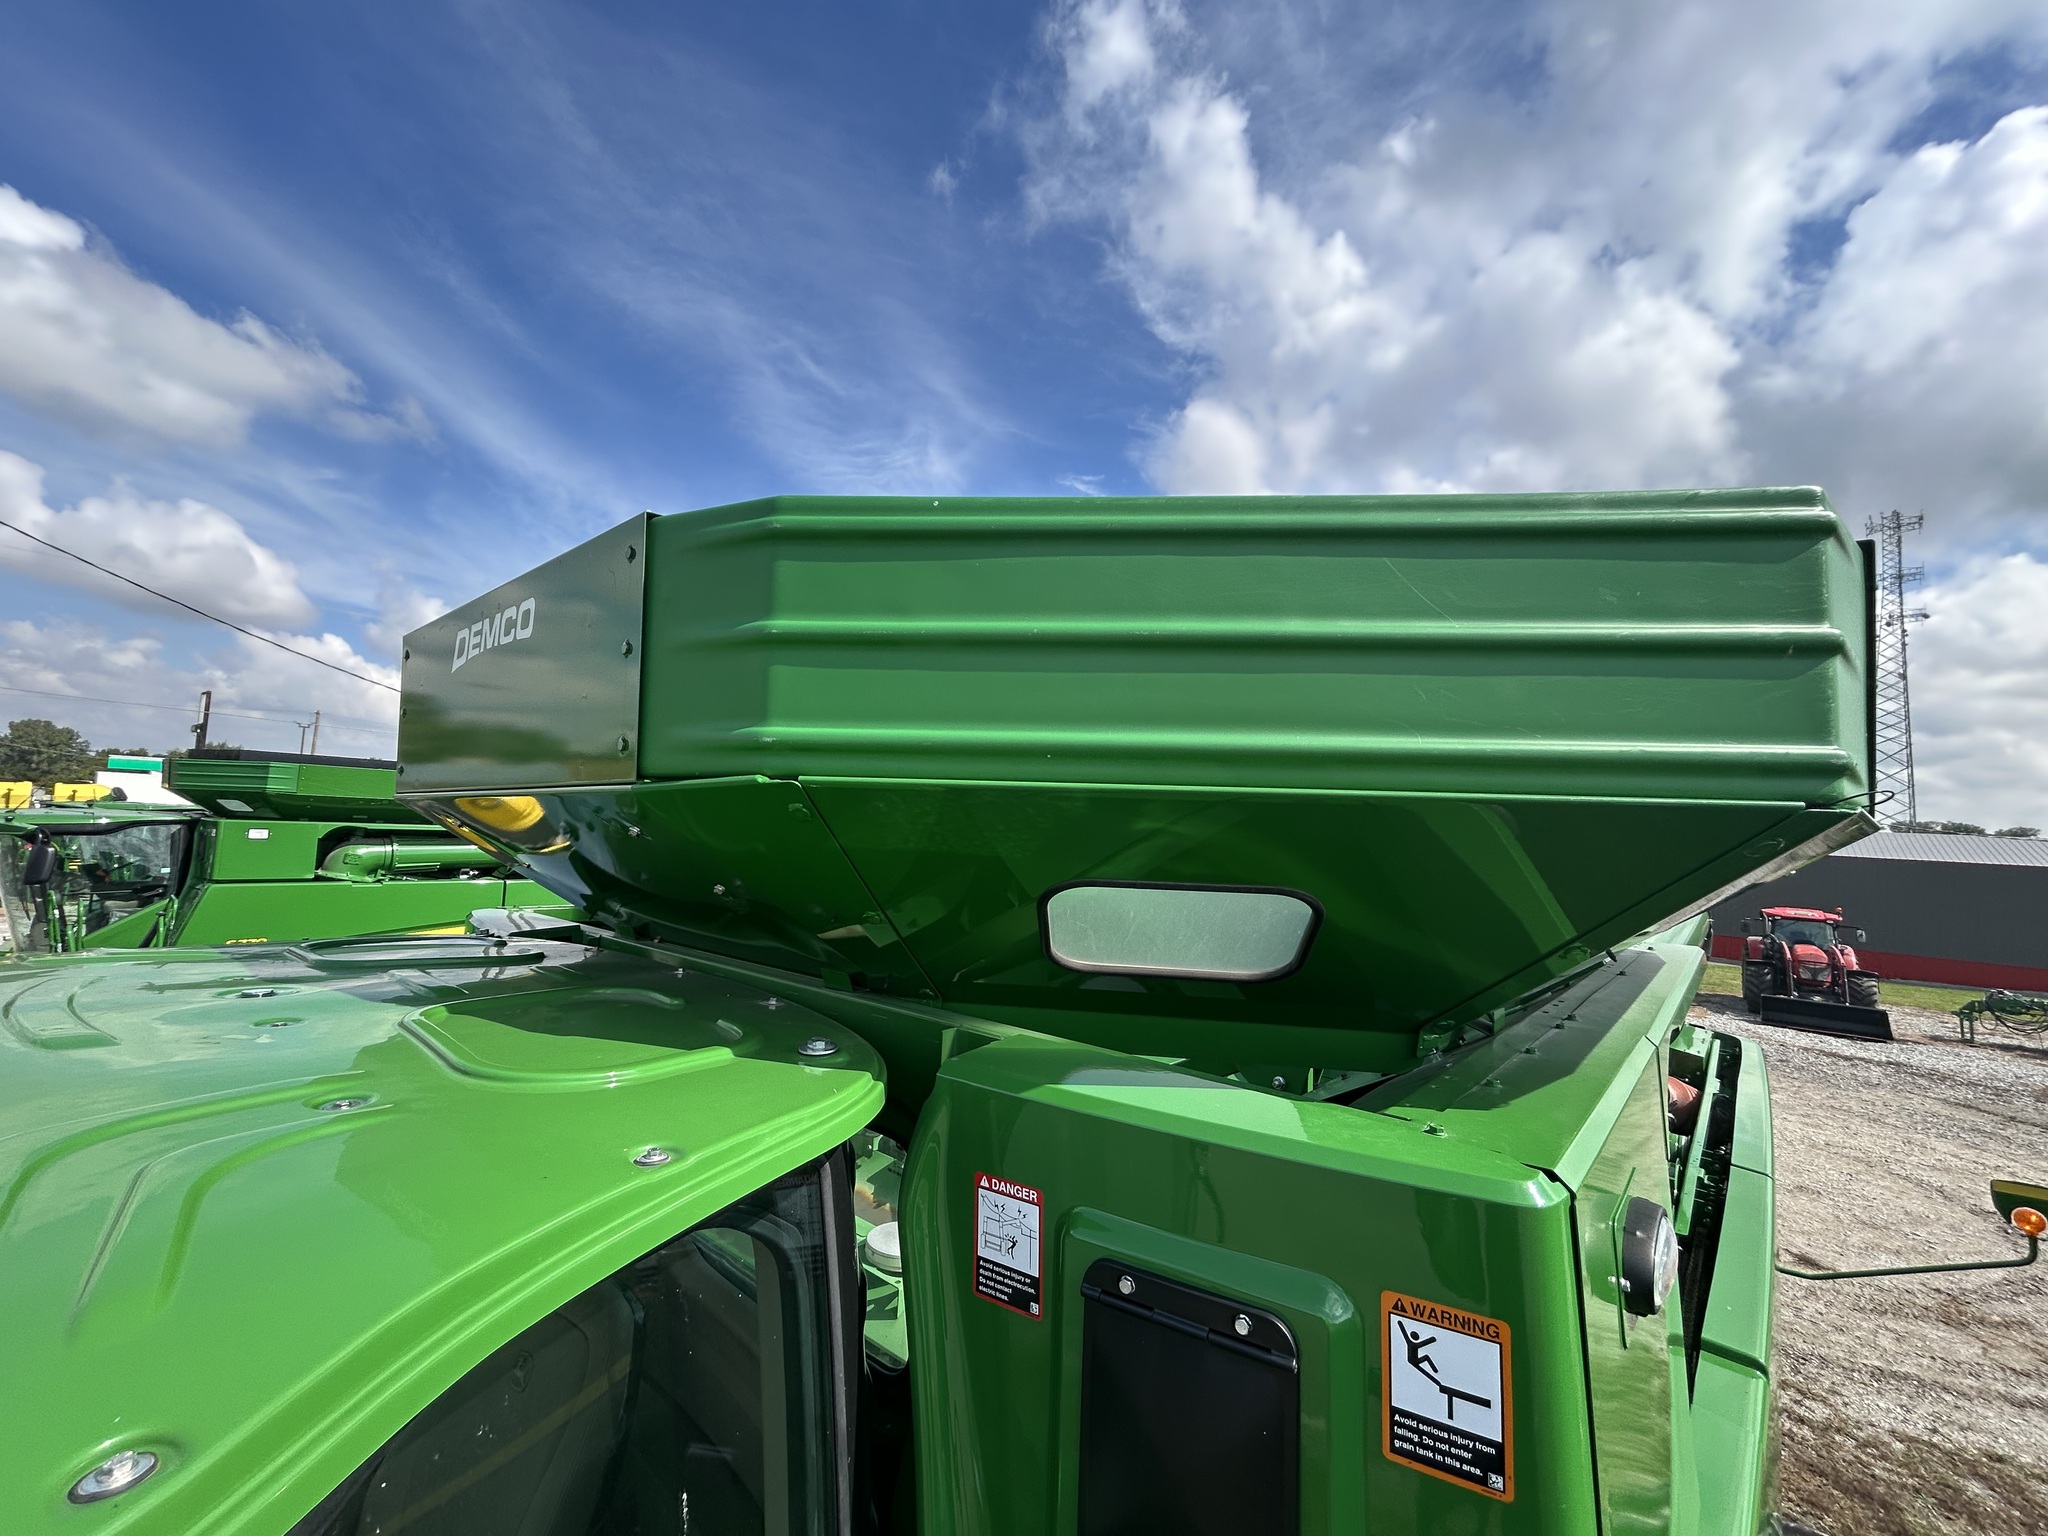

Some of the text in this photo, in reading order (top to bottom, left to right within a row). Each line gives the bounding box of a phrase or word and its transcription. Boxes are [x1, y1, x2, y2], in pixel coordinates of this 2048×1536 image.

[451, 597, 535, 673] DEMCO
[991, 1178, 1038, 1203] DANGER
[979, 1268, 993, 1278] death
[993, 1273, 1004, 1282] from
[979, 1276, 1012, 1294] Do not contact
[980, 1260, 993, 1270] Avoid
[993, 1265, 1010, 1276] serious
[1010, 1271, 1024, 1283] injury
[1409, 1301, 1500, 1340] WARNING
[1393, 1425, 1473, 1460] falling. Do not enter
[1394, 1413, 1496, 1455] Avoid serious injury from
[1393, 1439, 1483, 1476] grain tank in this area.
